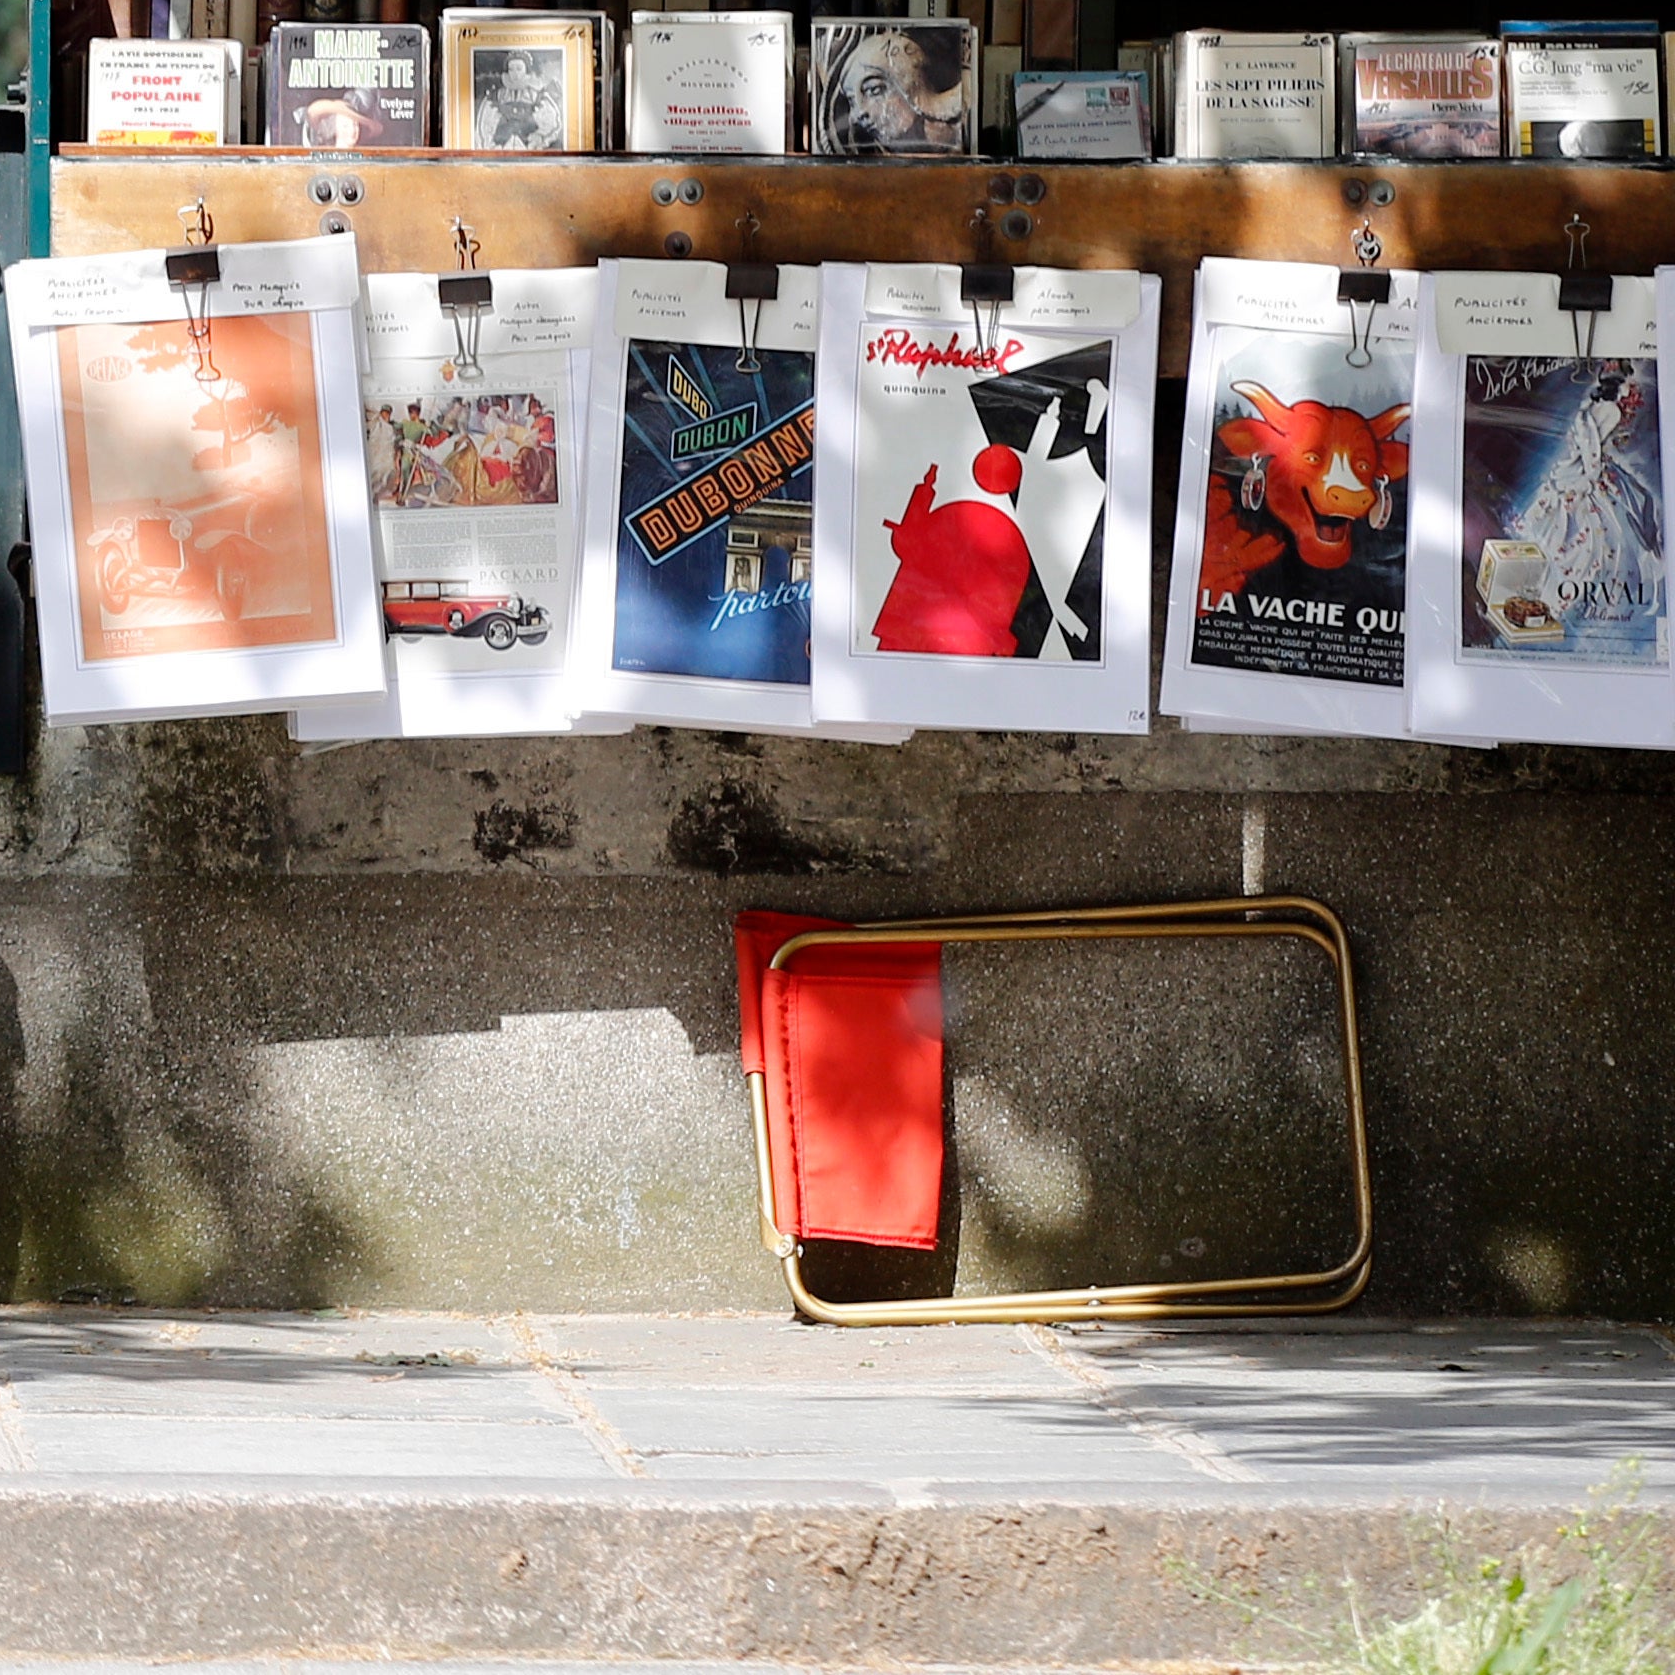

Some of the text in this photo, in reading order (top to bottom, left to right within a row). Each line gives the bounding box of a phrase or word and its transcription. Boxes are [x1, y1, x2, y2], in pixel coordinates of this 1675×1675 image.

[314, 29, 389, 60] MARIE-
[1247, 62, 1296, 70] LAWRENCE
[1378, 53, 1394, 72] LE
[1456, 51, 1472, 70] DE
[1518, 59, 1549, 75] C.G.
[1551, 59, 1583, 78] Jung
[131, 75, 182, 86] FRONT
[288, 58, 415, 89] ANTOINETTE
[1356, 58, 1493, 100] VERSAILLES
[1195, 79, 1325, 92] LES SEPT PILIERS
[111, 91, 202, 103] POPULAIRE
[380, 96, 415, 111] Evelyne
[1206, 96, 1316, 109] DE LA SAGESSE
[390, 108, 415, 120] Lever
[667, 105, 749, 117] Montaillou,
[1431, 102, 1458, 114] Pierre
[663, 118, 752, 128] village occitan
[1453, 296, 1528, 309] PUBLICITÉS
[1465, 315, 1533, 326] ANCIENNES
[671, 371, 709, 420] DUBO
[883, 384, 947, 397] quinquina
[677, 412, 748, 454] DUBON
[733, 477, 785, 515] QUINQUINA
[479, 567, 560, 582] PACKARD
[1557, 580, 1652, 608] ORVAL
[1200, 588, 1238, 620] LA
[1247, 593, 1347, 628] VACHE
[102, 628, 145, 640] DELAGE
[1199, 618, 1211, 627] LA
[1281, 627, 1299, 637] QUI
[1319, 631, 1345, 643] FAITE
[1349, 634, 1368, 645] DES
[1199, 628, 1221, 638] GRAS
[1223, 630, 1236, 641] DU
[1261, 635, 1273, 644] EN
[1315, 641, 1348, 654] TOUTES
[1349, 644, 1365, 655] LES
[1197, 639, 1247, 653] EMBALLAGE
[1310, 650, 1323, 661] ET
[1363, 668, 1375, 678] ET
[1377, 669, 1390, 680] SA
